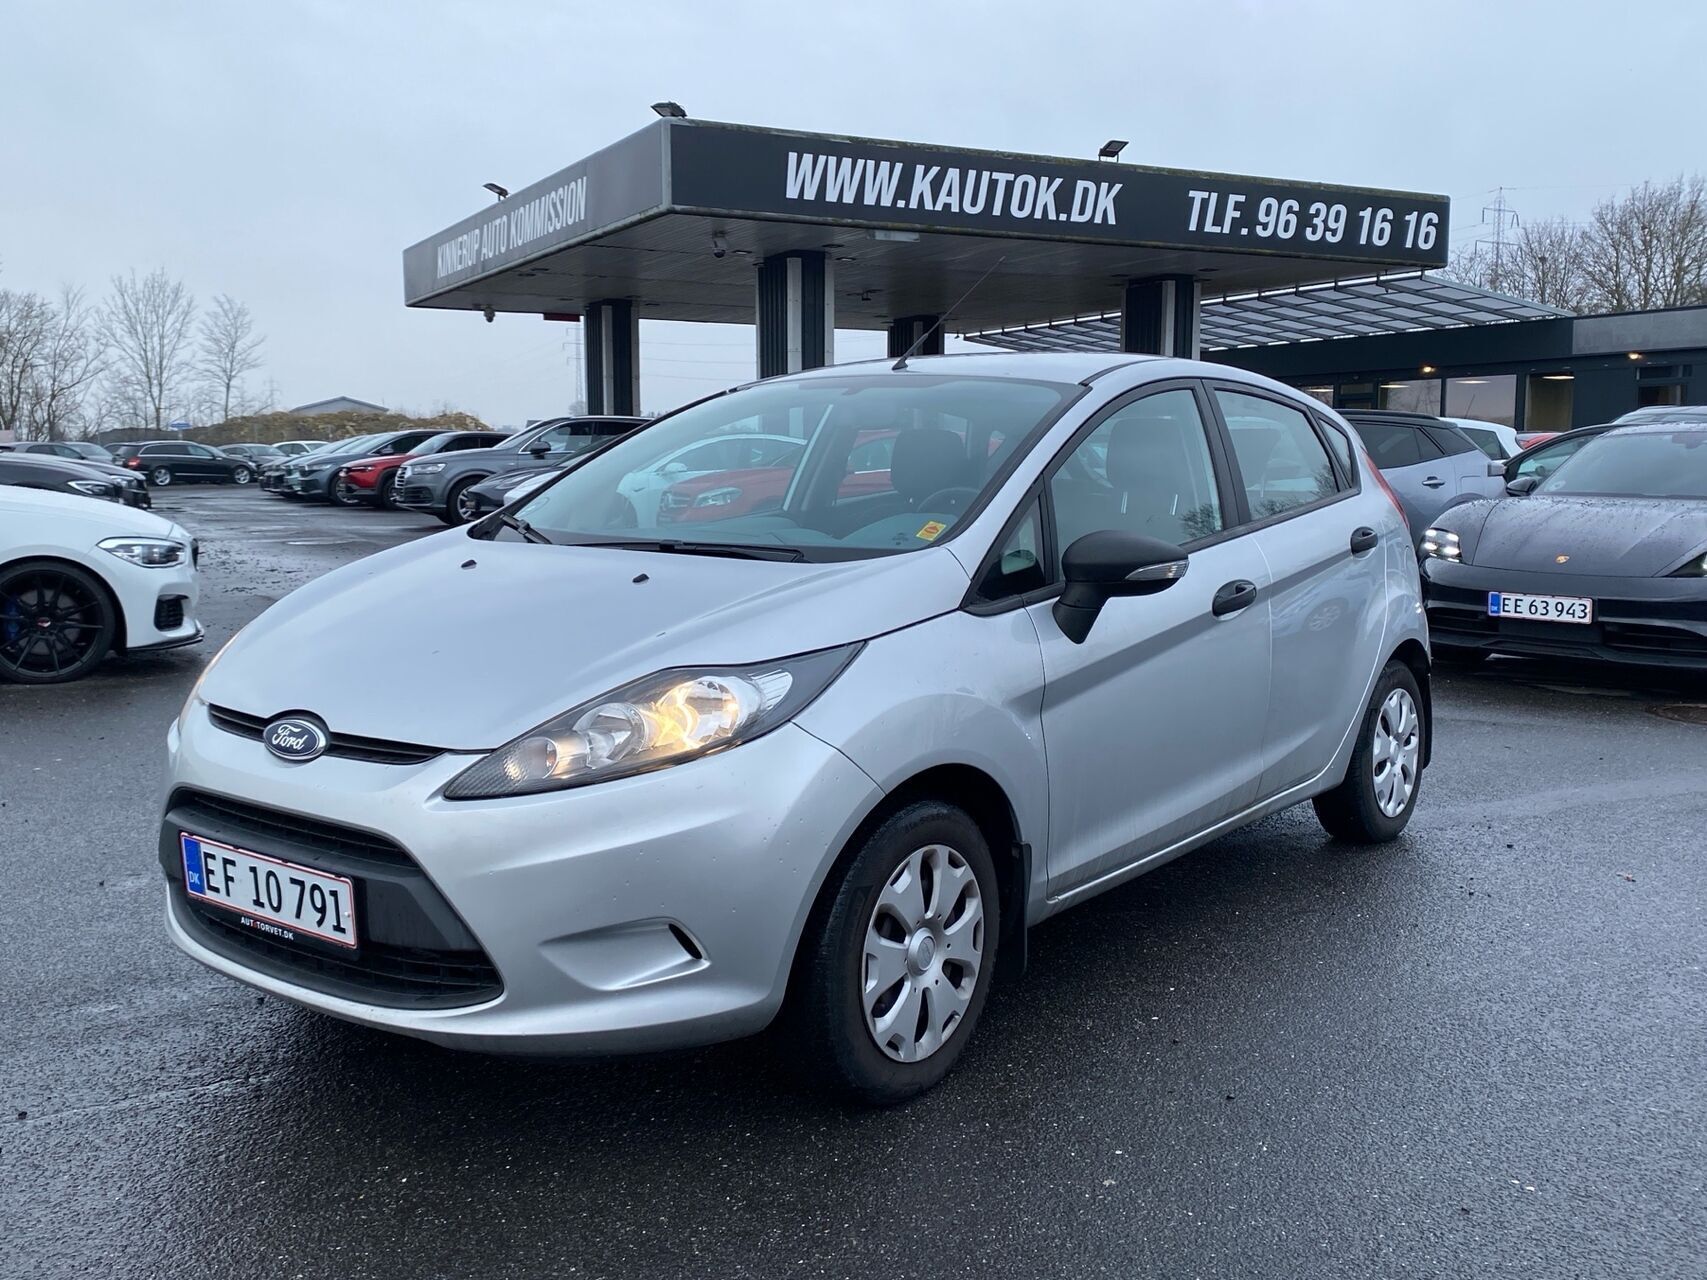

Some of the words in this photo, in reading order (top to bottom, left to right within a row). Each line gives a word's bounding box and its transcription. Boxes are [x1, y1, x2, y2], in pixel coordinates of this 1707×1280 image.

[437, 228, 480, 279] KINNERUP
[481, 215, 507, 261] AUTO
[509, 176, 587, 249] KOMMISSION
[786, 152, 1123, 225] WWW.KAUTOK.DK
[1188, 190, 1248, 235] TLF.
[1256, 197, 1299, 239] 96
[1305, 202, 1347, 243] 39
[1358, 207, 1394, 247] 16
[1404, 211, 1439, 250] 16
[1502, 598, 1523, 613] EE
[1529, 600, 1549, 615] 63
[1555, 602, 1588, 619] 943
[272, 724, 308, 750] Ford
[189, 871, 200, 884] DK
[203, 851, 236, 897] EF
[249, 866, 282, 913] 10
[289, 877, 346, 934] 791
